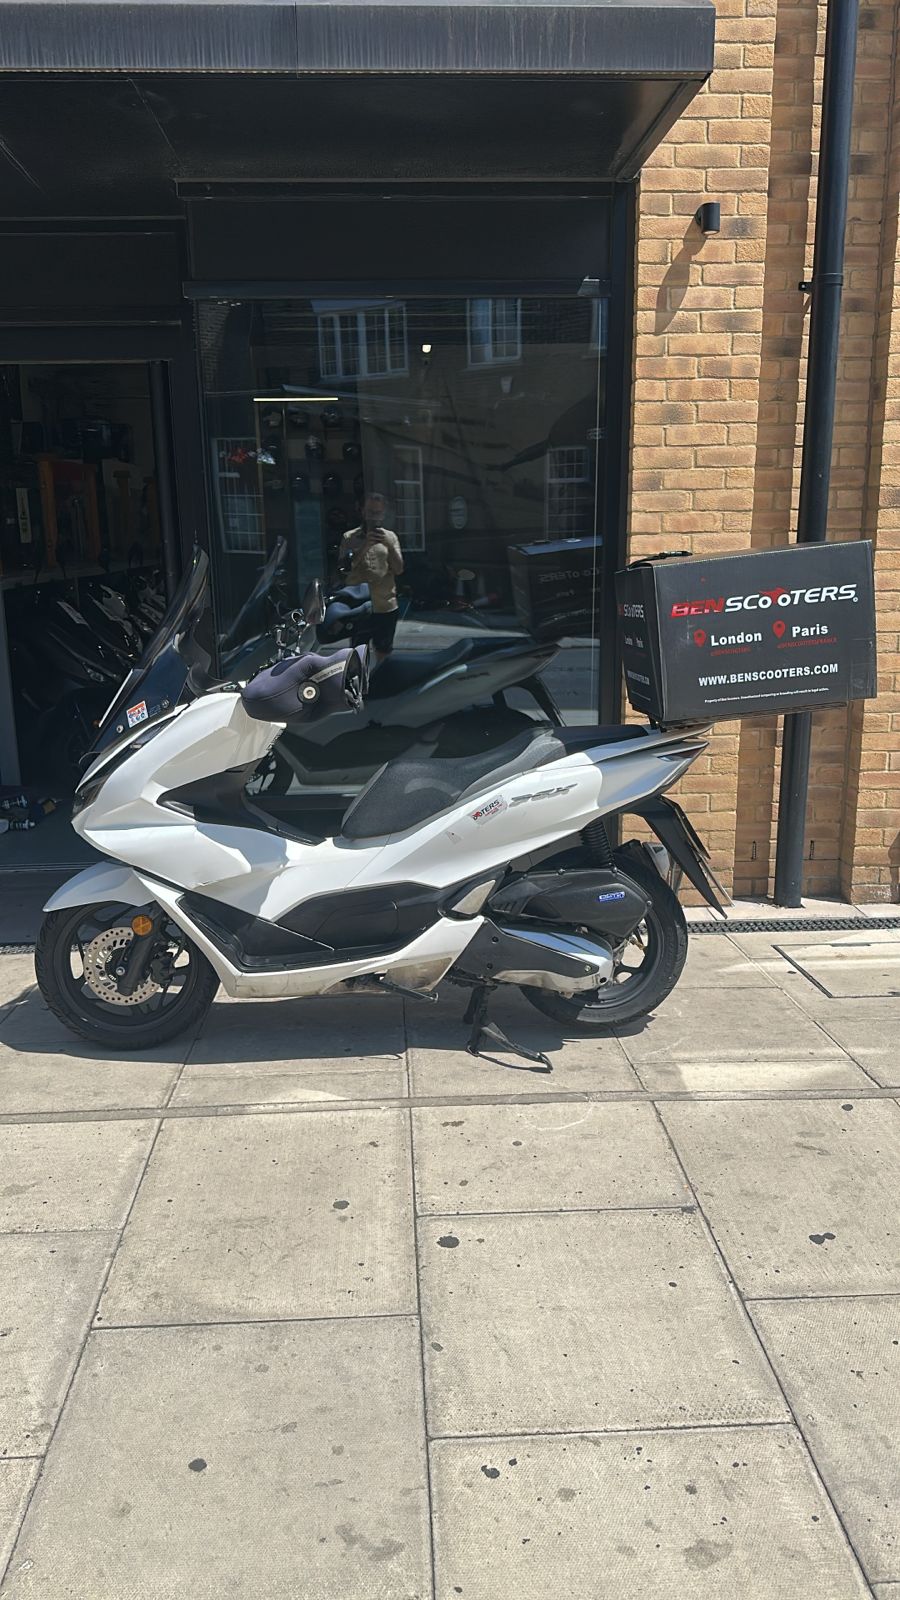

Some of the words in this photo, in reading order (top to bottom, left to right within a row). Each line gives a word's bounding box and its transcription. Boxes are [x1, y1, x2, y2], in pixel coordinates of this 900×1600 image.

[791, 623, 829, 638] Paris
[710, 631, 763, 647] London
[698, 663, 839, 687] WWW.BENSCOOTERS.COM
